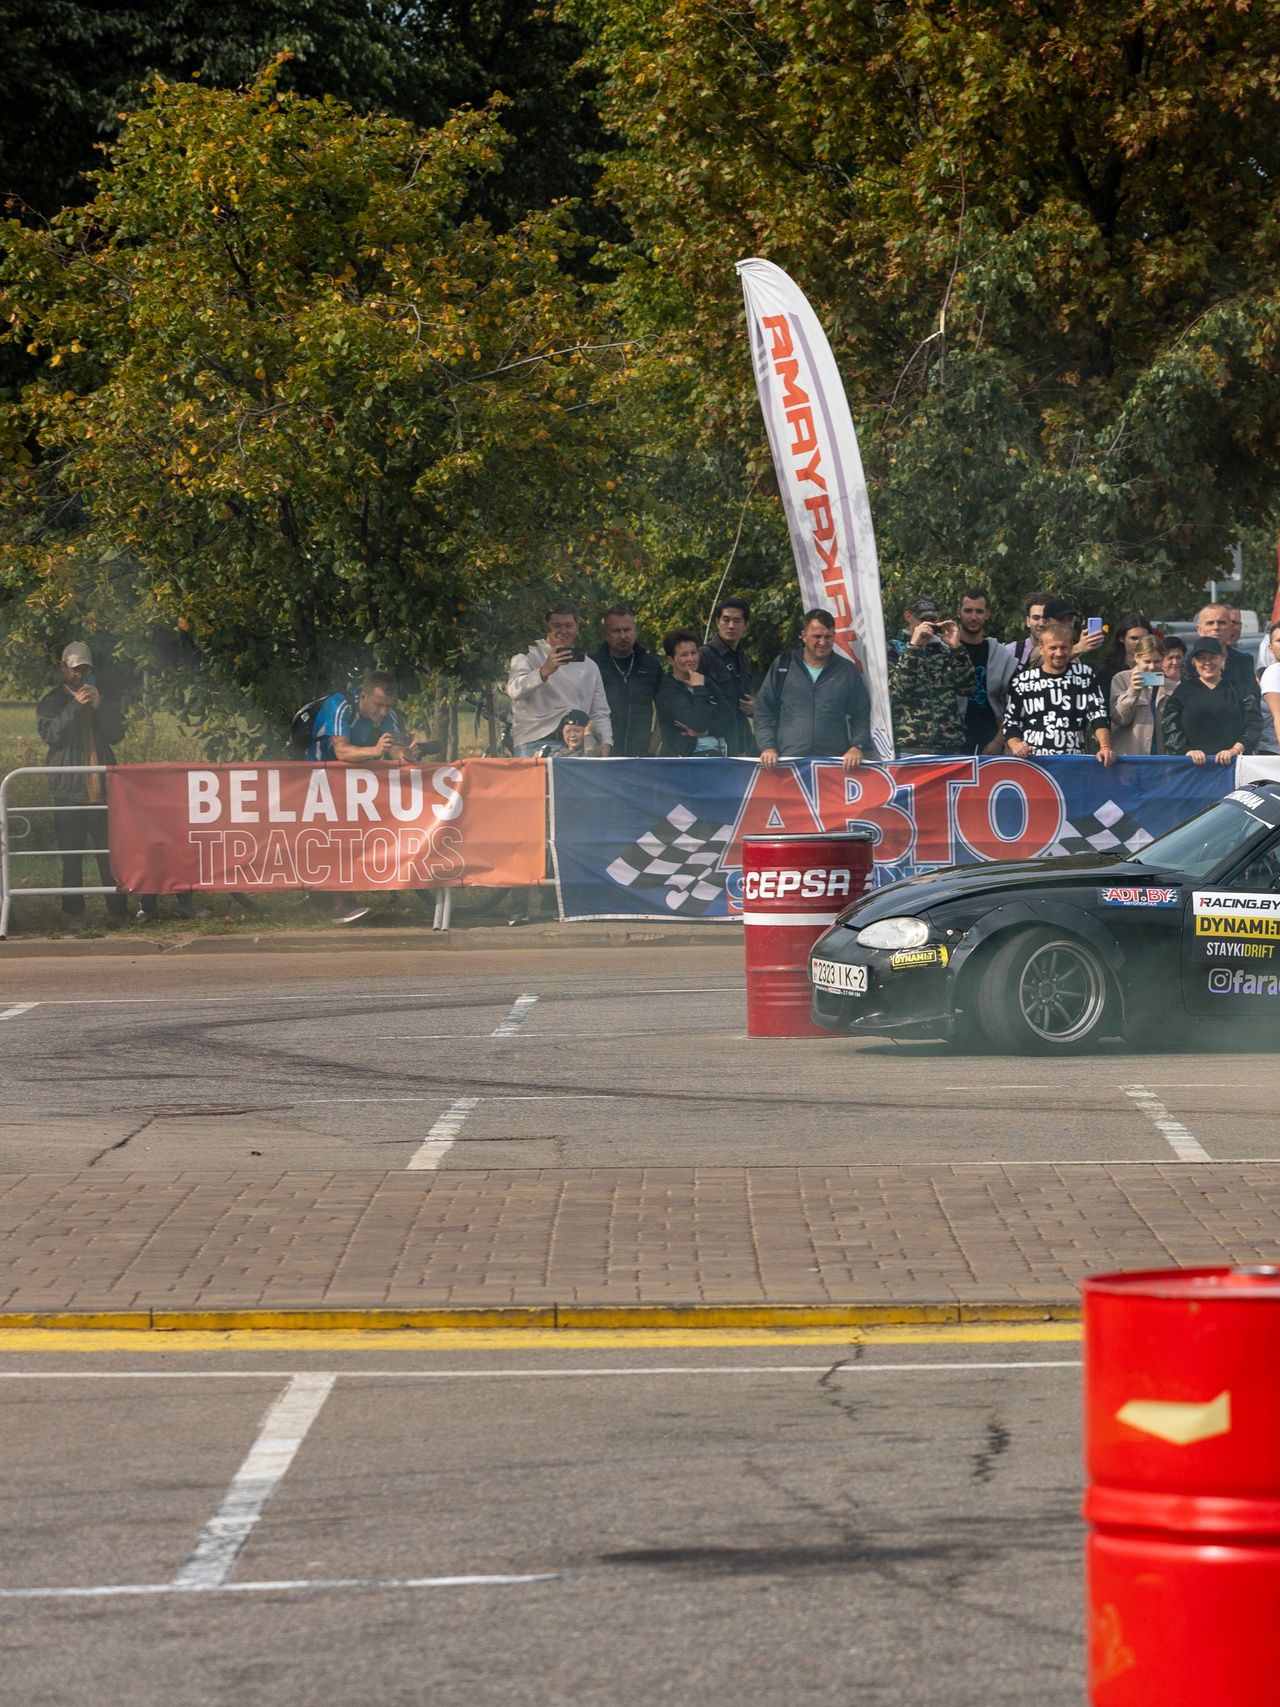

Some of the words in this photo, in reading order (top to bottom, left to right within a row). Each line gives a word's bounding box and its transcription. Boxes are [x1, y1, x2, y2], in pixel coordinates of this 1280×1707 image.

[187, 766, 464, 824] BELARUS
[717, 757, 1066, 871] АВТО
[188, 825, 465, 886] TRACTORS
[745, 868, 851, 900] CEPSA
[818, 962, 836, 985] 2323
